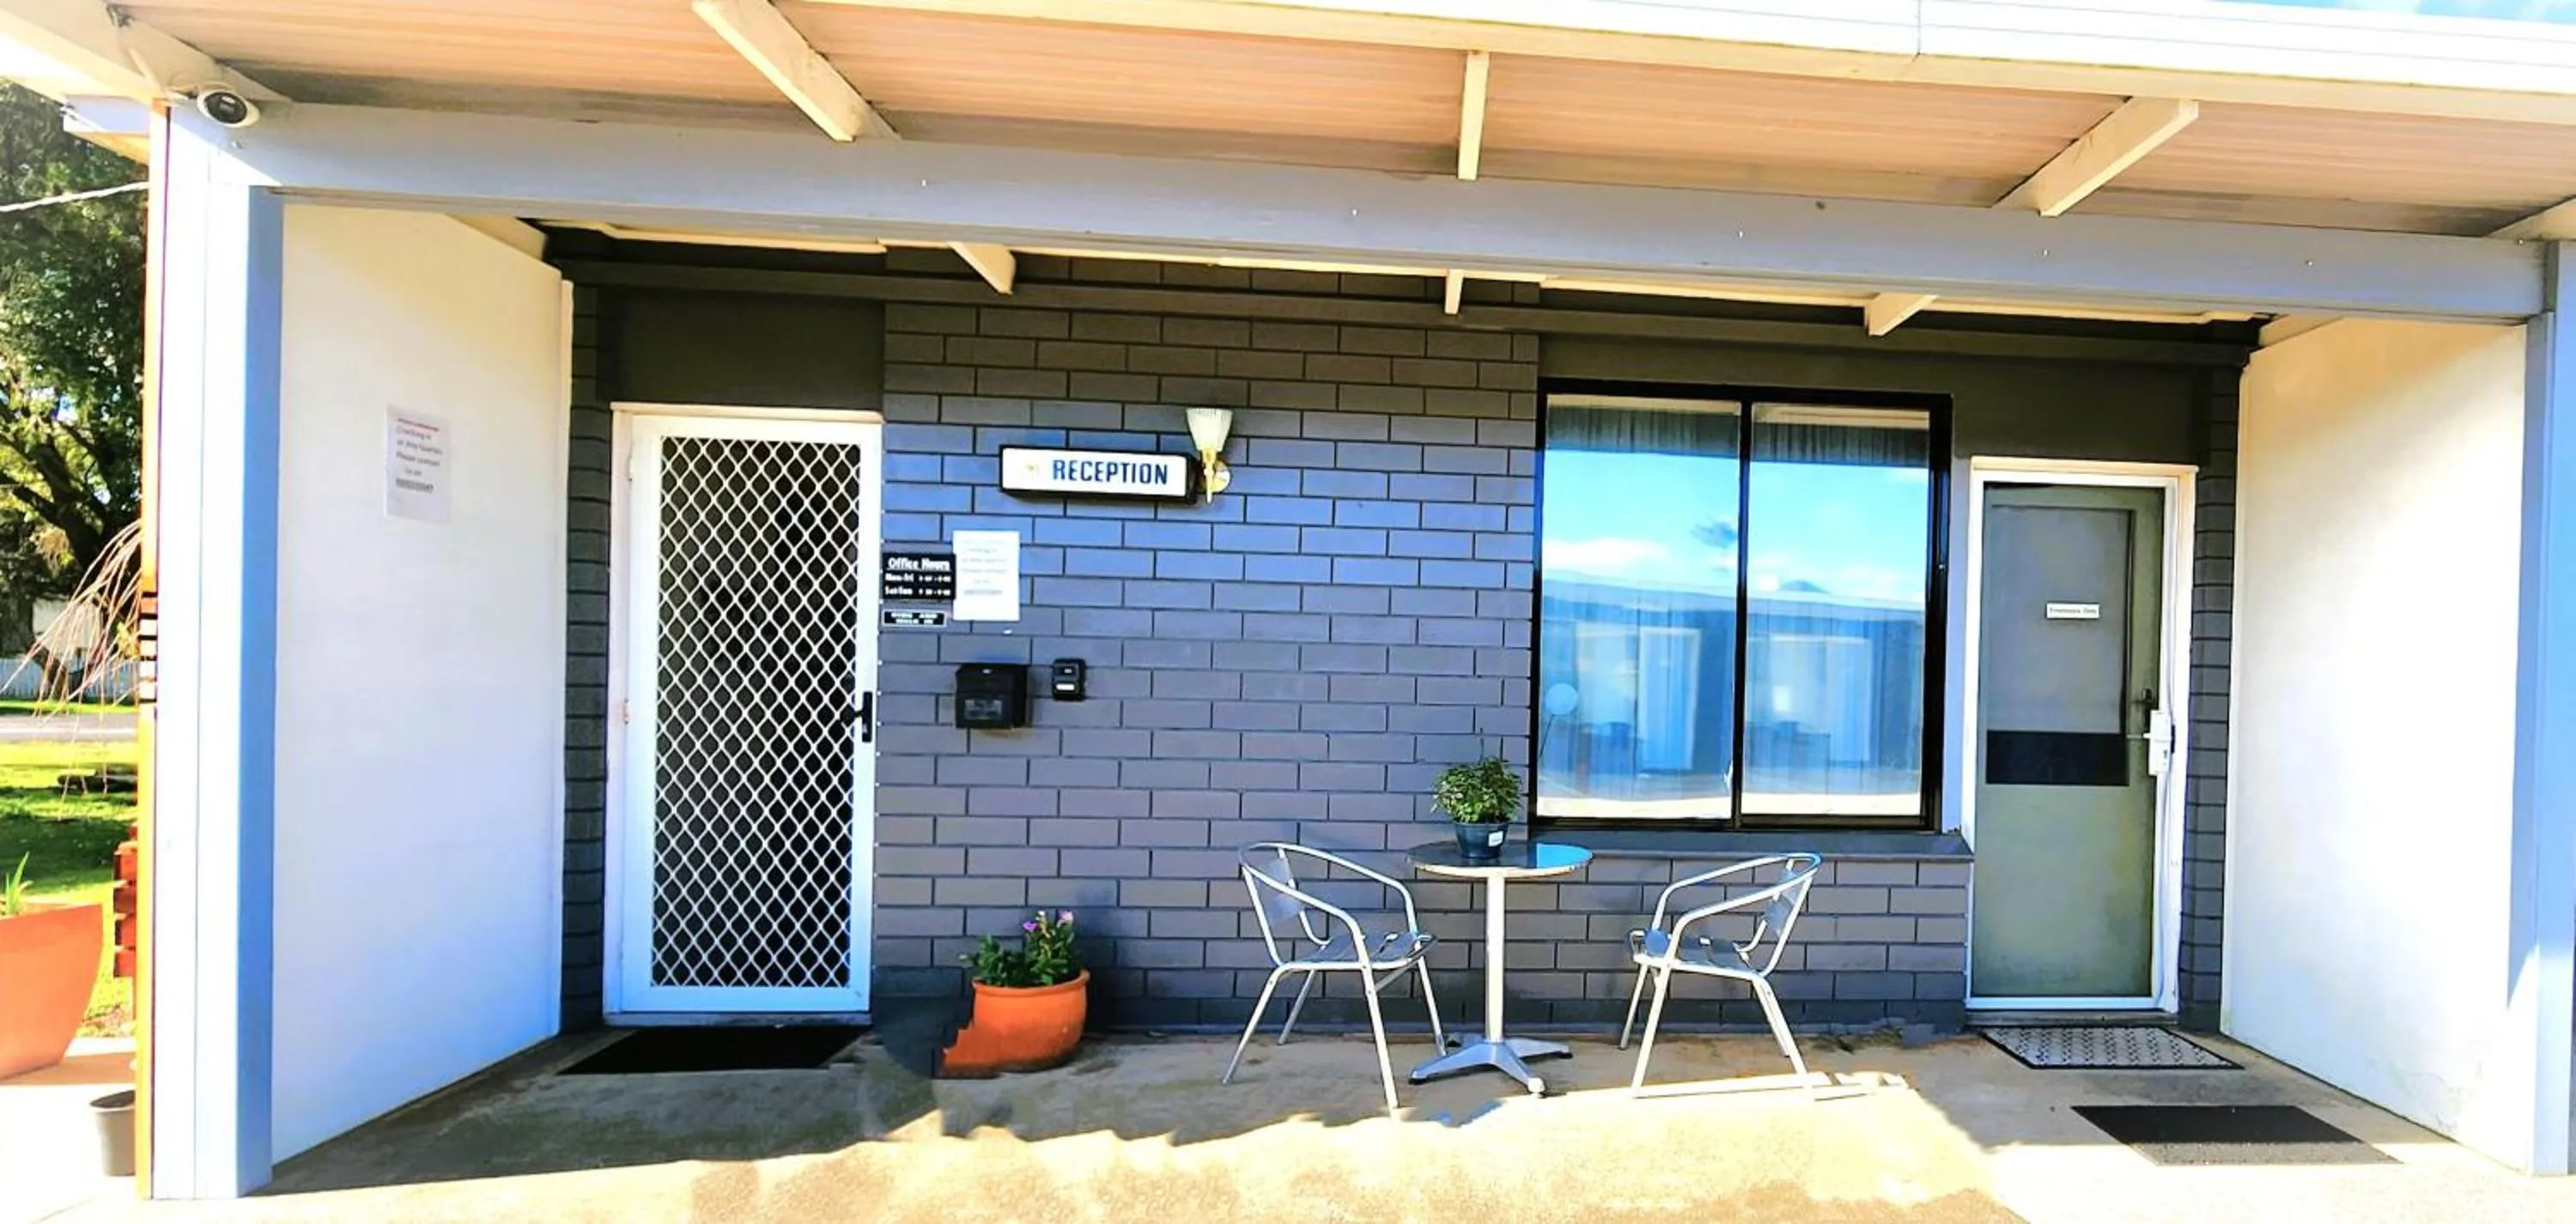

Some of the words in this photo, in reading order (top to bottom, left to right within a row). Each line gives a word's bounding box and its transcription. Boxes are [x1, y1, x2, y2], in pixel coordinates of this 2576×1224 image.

[1053, 459, 1168, 485] RECEPTION
[888, 557, 919, 570] Office
[921, 557, 951, 572] Hours
